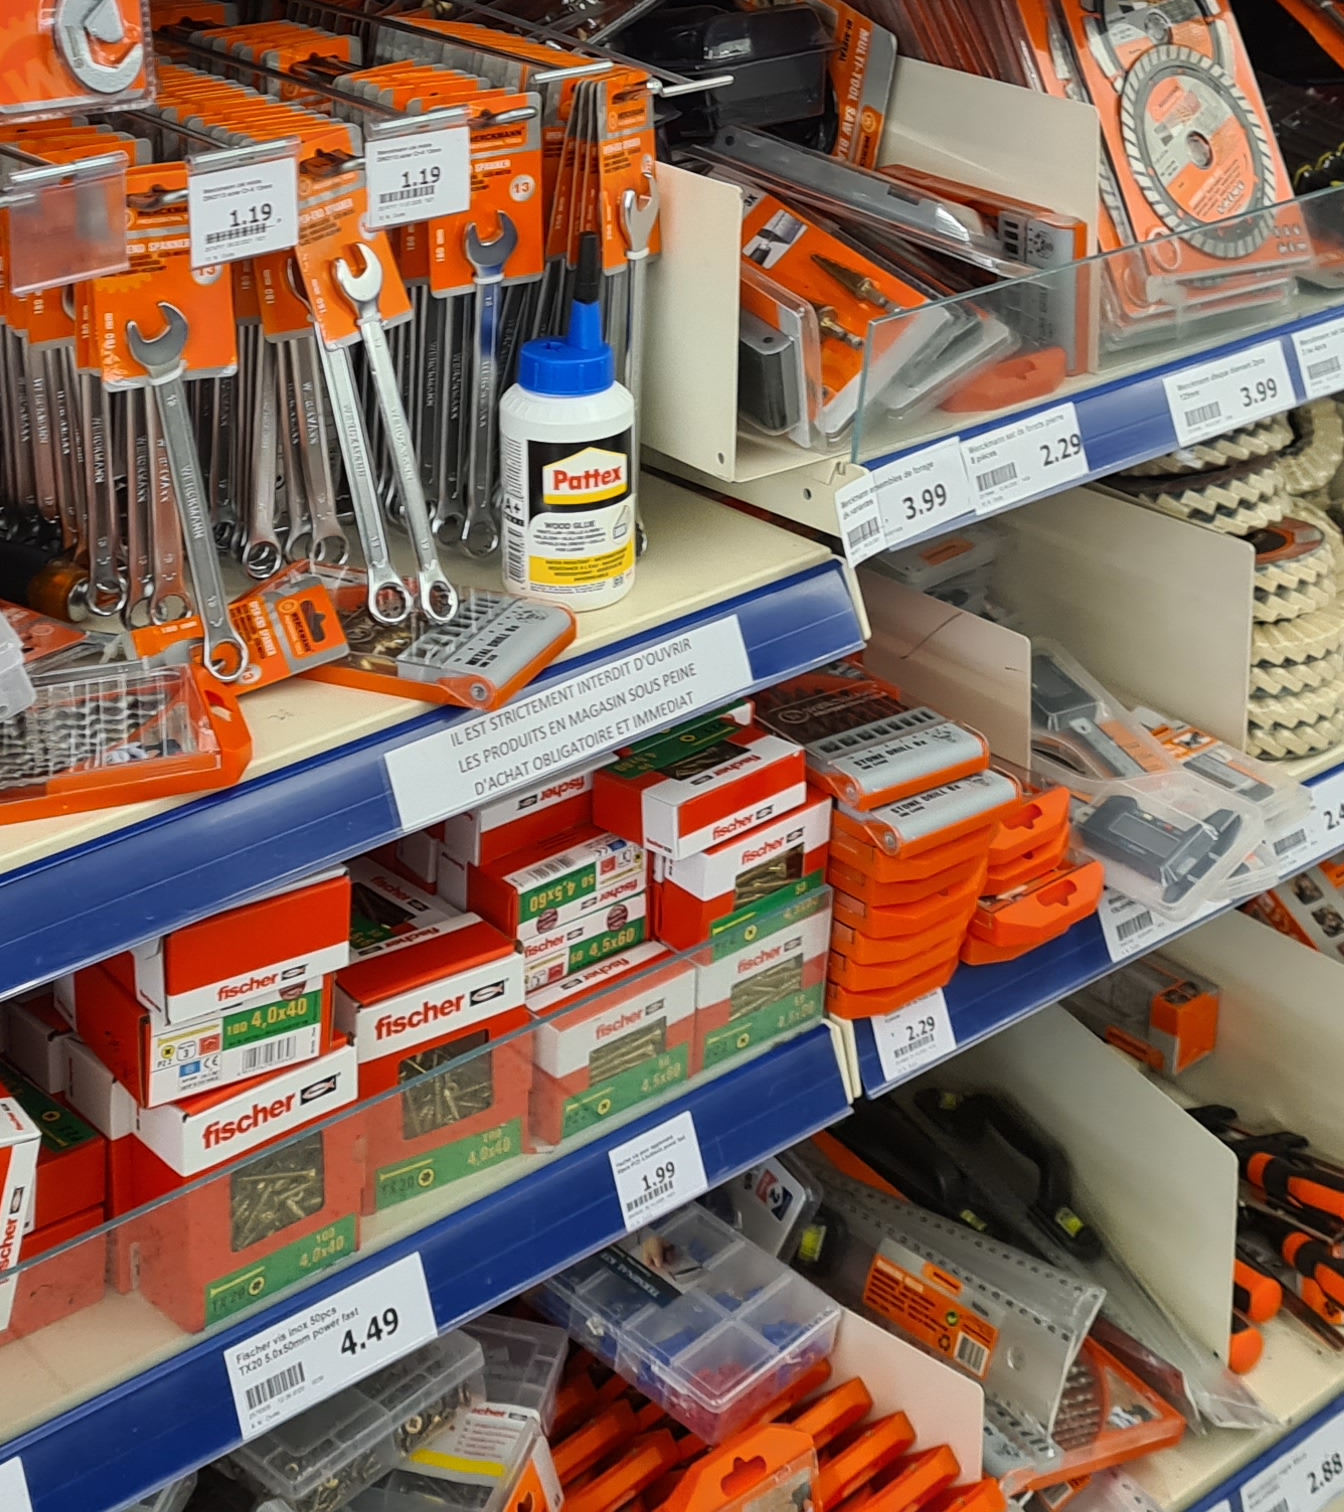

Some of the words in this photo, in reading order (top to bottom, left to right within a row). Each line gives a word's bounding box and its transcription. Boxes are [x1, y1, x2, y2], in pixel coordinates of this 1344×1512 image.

[401, 166, 441, 188] 1.19
[513, 182, 530, 193] 13
[229, 203, 274, 227] 1.19
[1239, 377, 1278, 408] 3.99
[1039, 433, 1082, 467] 2.29
[553, 465, 622, 491] Pattex
[902, 483, 947, 521] 3.99
[544, 522, 570, 530] WOOD
[451, 729, 462, 749] IL
[464, 719, 488, 745] EST
[490, 683, 576, 733] STRICTEMENT
[577, 660, 632, 697] INTERDIT
[633, 638, 692, 674] D'OUVRIR
[458, 750, 481, 775] LES
[484, 723, 547, 764] PRODUITS
[551, 714, 567, 736] EN
[569, 689, 627, 728] MAGASIN
[630, 674, 661, 703] SOUS
[663, 661, 698, 690] PEINE
[475, 759, 530, 796] D'ACHAT
[532, 723, 614, 773] OBLIGATOIRE
[617, 716, 631, 737] ET
[633, 690, 695, 731] IMMEDIAT
[854, 753, 885, 769] STONE
[887, 744, 914, 759] DRILL
[714, 753, 762, 777] fischer
[540, 776, 586, 802] fischer
[891, 799, 920, 816] STONE
[923, 789, 949, 803] DRILL
[712, 814, 755, 841] fischer
[741, 836, 786, 866] fischer
[598, 879, 639, 903] fischer
[524, 934, 565, 959] fischer
[589, 927, 636, 958] 4,5x60
[584, 956, 631, 981] fischer
[737, 945, 783, 975] fischer
[217, 972, 279, 1002] fischer
[227, 1021, 248, 1037] 100
[250, 999, 309, 1030] 4,0x40
[374, 993, 465, 1041] fischer
[594, 1007, 645, 1040] fischer
[905, 1016, 936, 1043] 2.29
[202, 1093, 296, 1150] fischer
[641, 1161, 676, 1192] 1.99
[299, 1236, 346, 1268] 4,0x40
[236, 1340, 271, 1364] Fischer
[273, 1332, 287, 1346] vis
[288, 1322, 308, 1339] inox
[310, 1307, 337, 1327] 50pcs
[238, 1357, 263, 1377] TX20
[265, 1335, 311, 1365] 5.0x50mm
[312, 1319, 340, 1342] power
[341, 1307, 359, 1325] fast
[340, 1308, 399, 1357] 4.49
[1306, 1452, 1344, 1495] 2.88
